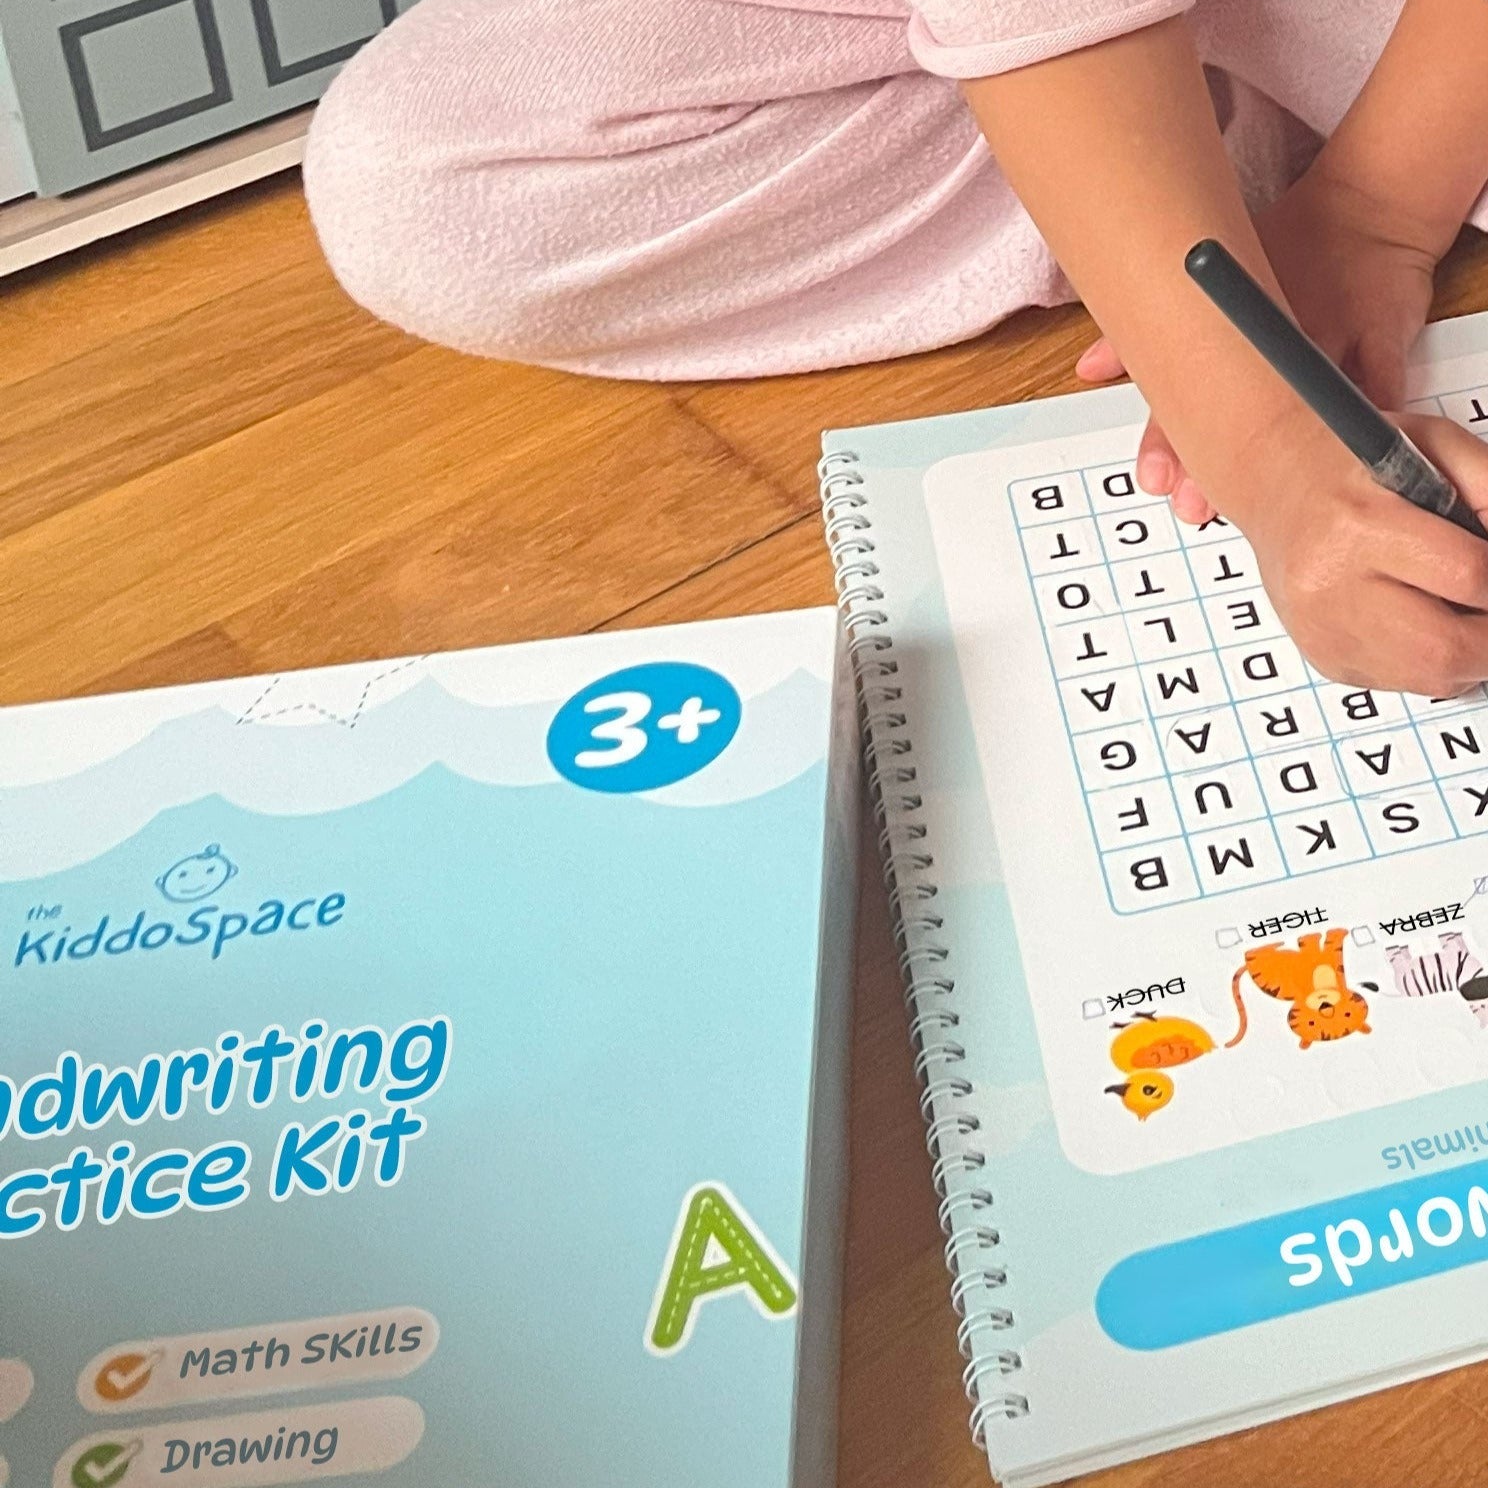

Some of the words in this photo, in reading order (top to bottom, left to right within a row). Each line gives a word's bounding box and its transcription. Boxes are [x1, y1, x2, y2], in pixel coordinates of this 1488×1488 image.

[1030, 484, 1065, 511] B
[1102, 471, 1136, 498] D
[1049, 532, 1080, 560] T
[1114, 519, 1150, 546] C
[1133, 569, 1166, 598] T
[1213, 553, 1245, 583] T
[1056, 582, 1091, 611] O
[1143, 616, 1178, 644] L
[1226, 600, 1262, 631] E
[1075, 632, 1109, 662] T
[1155, 666, 1200, 701] M
[1241, 651, 1280, 682] D
[1079, 681, 1117, 713] A
[1340, 688, 1380, 721] B
[572, 690, 721, 768] 3+
[1173, 721, 1212, 755] A
[1260, 705, 1300, 738] R
[1099, 740, 1138, 772] G
[1354, 743, 1393, 777] A
[1439, 725, 1482, 761] N
[1278, 760, 1319, 795] D
[1117, 796, 1150, 833] F
[1193, 781, 1234, 816] U
[1381, 801, 1421, 835] S
[1296, 819, 1338, 856] K
[1207, 837, 1255, 876] M
[1129, 856, 1170, 892] B
[14, 892, 346, 968] KiddoSpace
[1247, 906, 1330, 940] TIGER
[1378, 902, 1466, 938] ZEBRA
[1105, 976, 1188, 1012] DUCK
[274, 1107, 422, 1198] Kit
[179, 1337, 291, 1379] Math
[160, 1426, 339, 1474] Drawing
